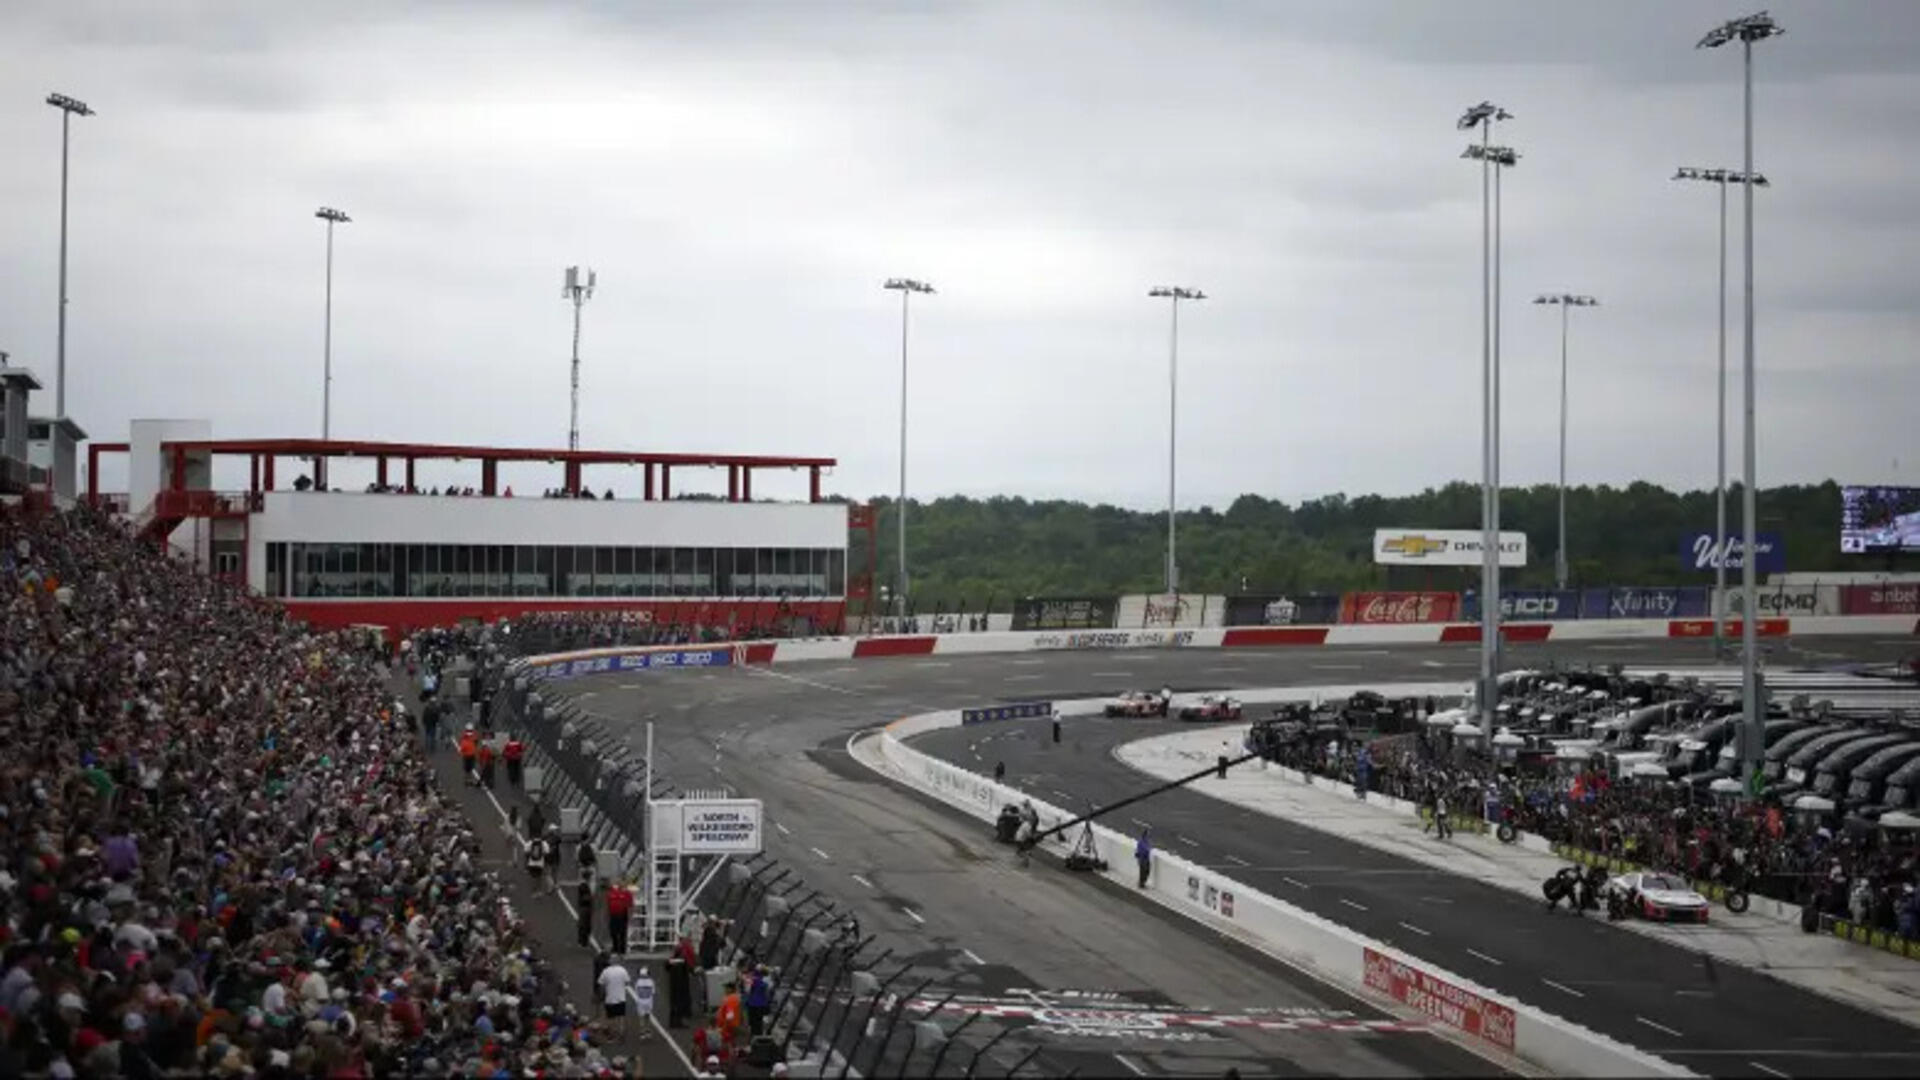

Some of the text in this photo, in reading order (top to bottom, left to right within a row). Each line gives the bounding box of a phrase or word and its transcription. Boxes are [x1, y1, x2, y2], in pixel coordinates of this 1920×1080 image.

[1454, 541, 1521, 552] CHEVLET
[1693, 535, 1772, 567] Winow
[1499, 597, 1559, 614] EICO
[703, 813, 739, 821] NORTH
